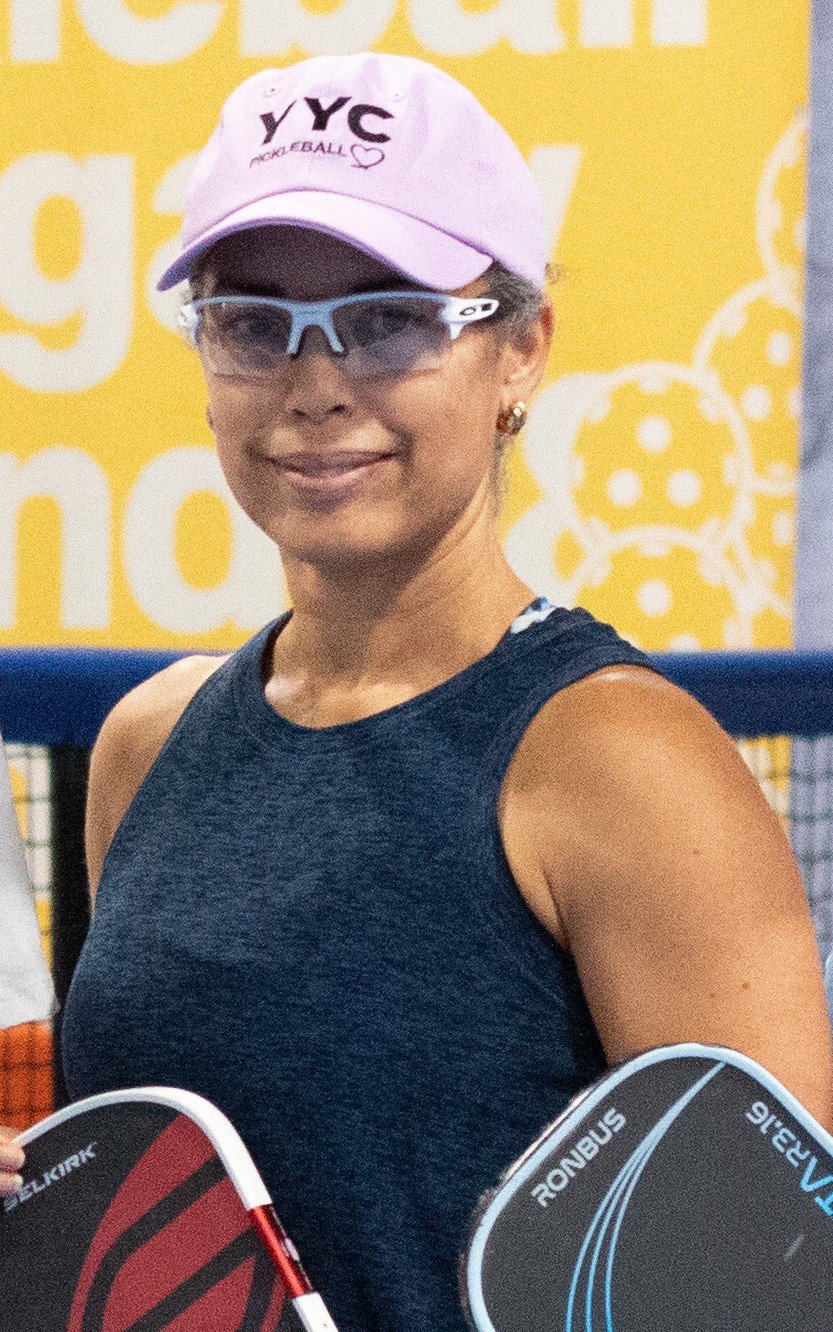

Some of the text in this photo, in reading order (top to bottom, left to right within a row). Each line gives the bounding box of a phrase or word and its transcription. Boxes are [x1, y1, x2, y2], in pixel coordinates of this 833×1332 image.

[259, 96, 395, 146] YYC
[3, 1141, 98, 1213] SELKIRK
[530, 1107, 626, 1208] RONBUS
